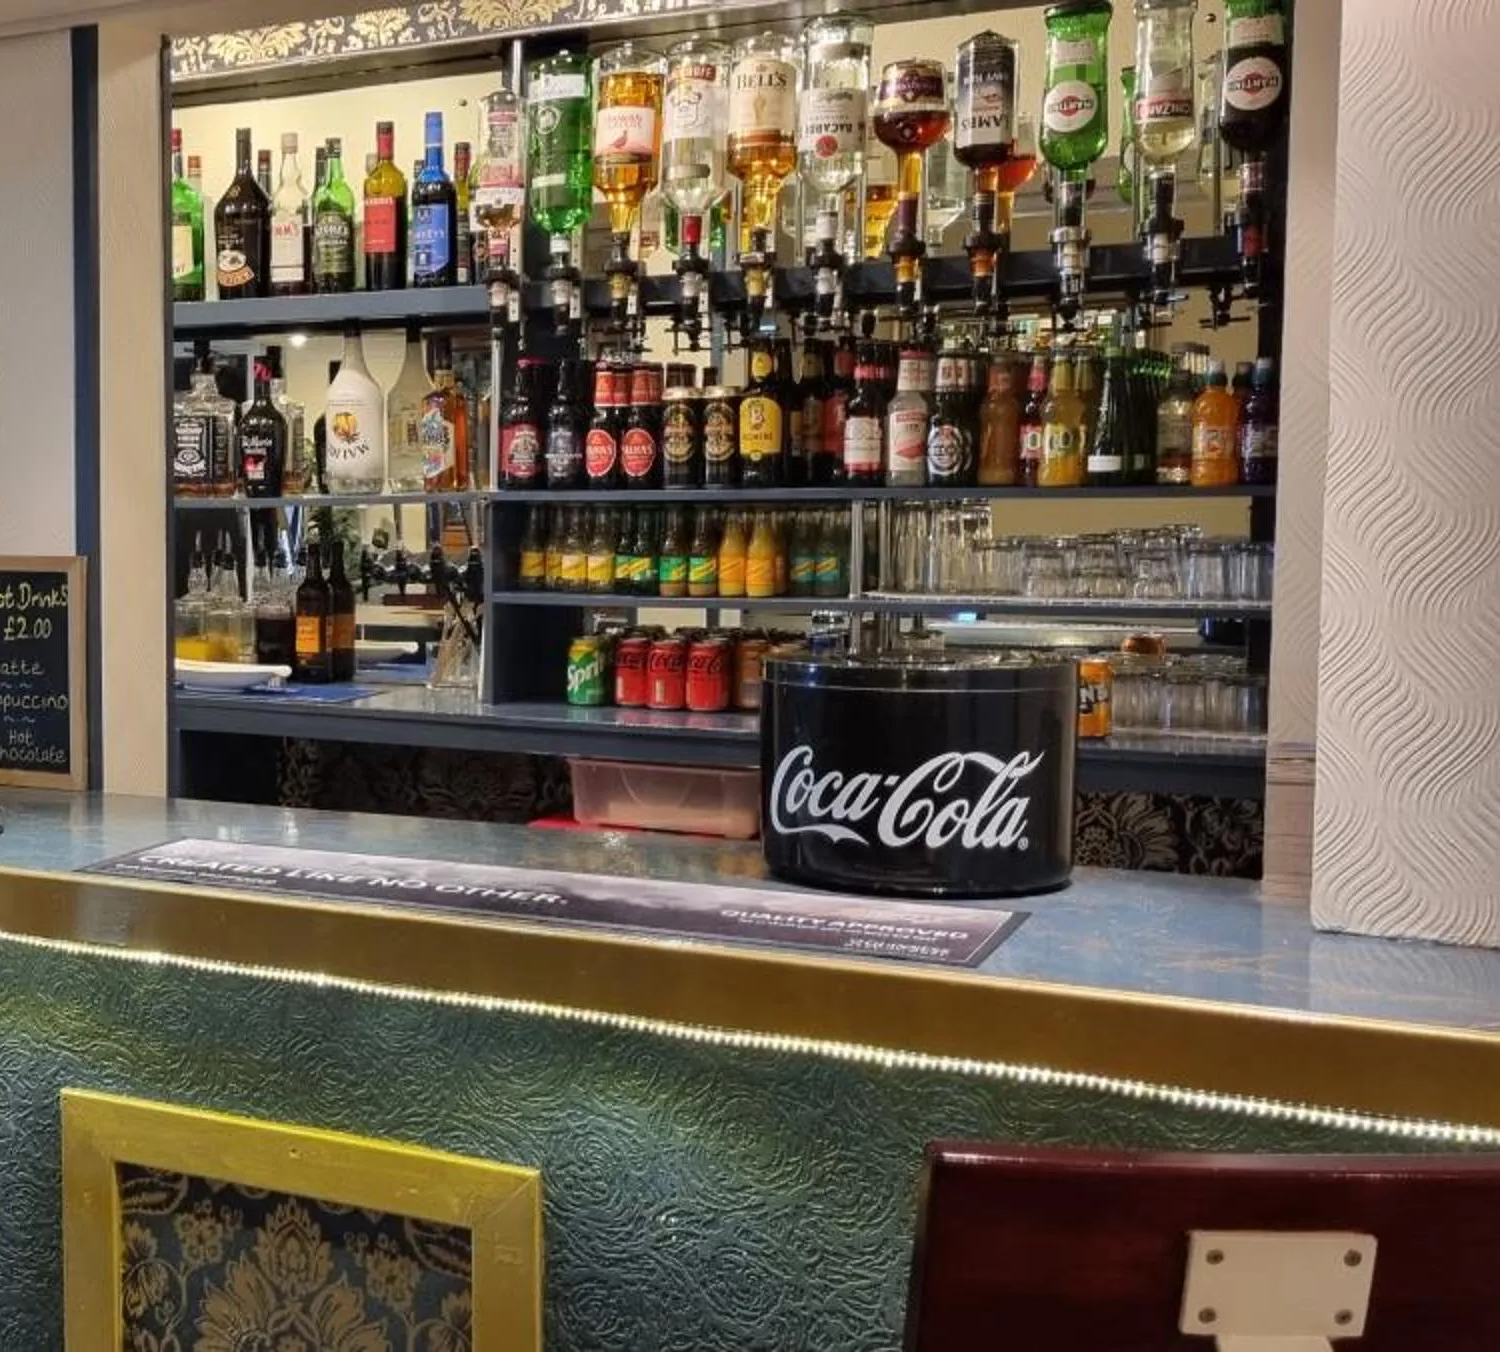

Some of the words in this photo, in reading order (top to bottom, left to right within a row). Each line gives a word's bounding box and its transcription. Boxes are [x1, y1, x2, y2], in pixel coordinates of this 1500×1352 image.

[737, 71, 788, 90] BELL'S
[3, 616, 52, 641] £2.00
[9, 728, 34, 746] Hot
[770, 744, 1046, 850] Coca-Cola
[139, 855, 282, 875] CREATED
[284, 867, 364, 883] LIKE
[368, 878, 428, 889] NO
[720, 909, 826, 926] QUALITY
[827, 919, 969, 940] APPROVED
